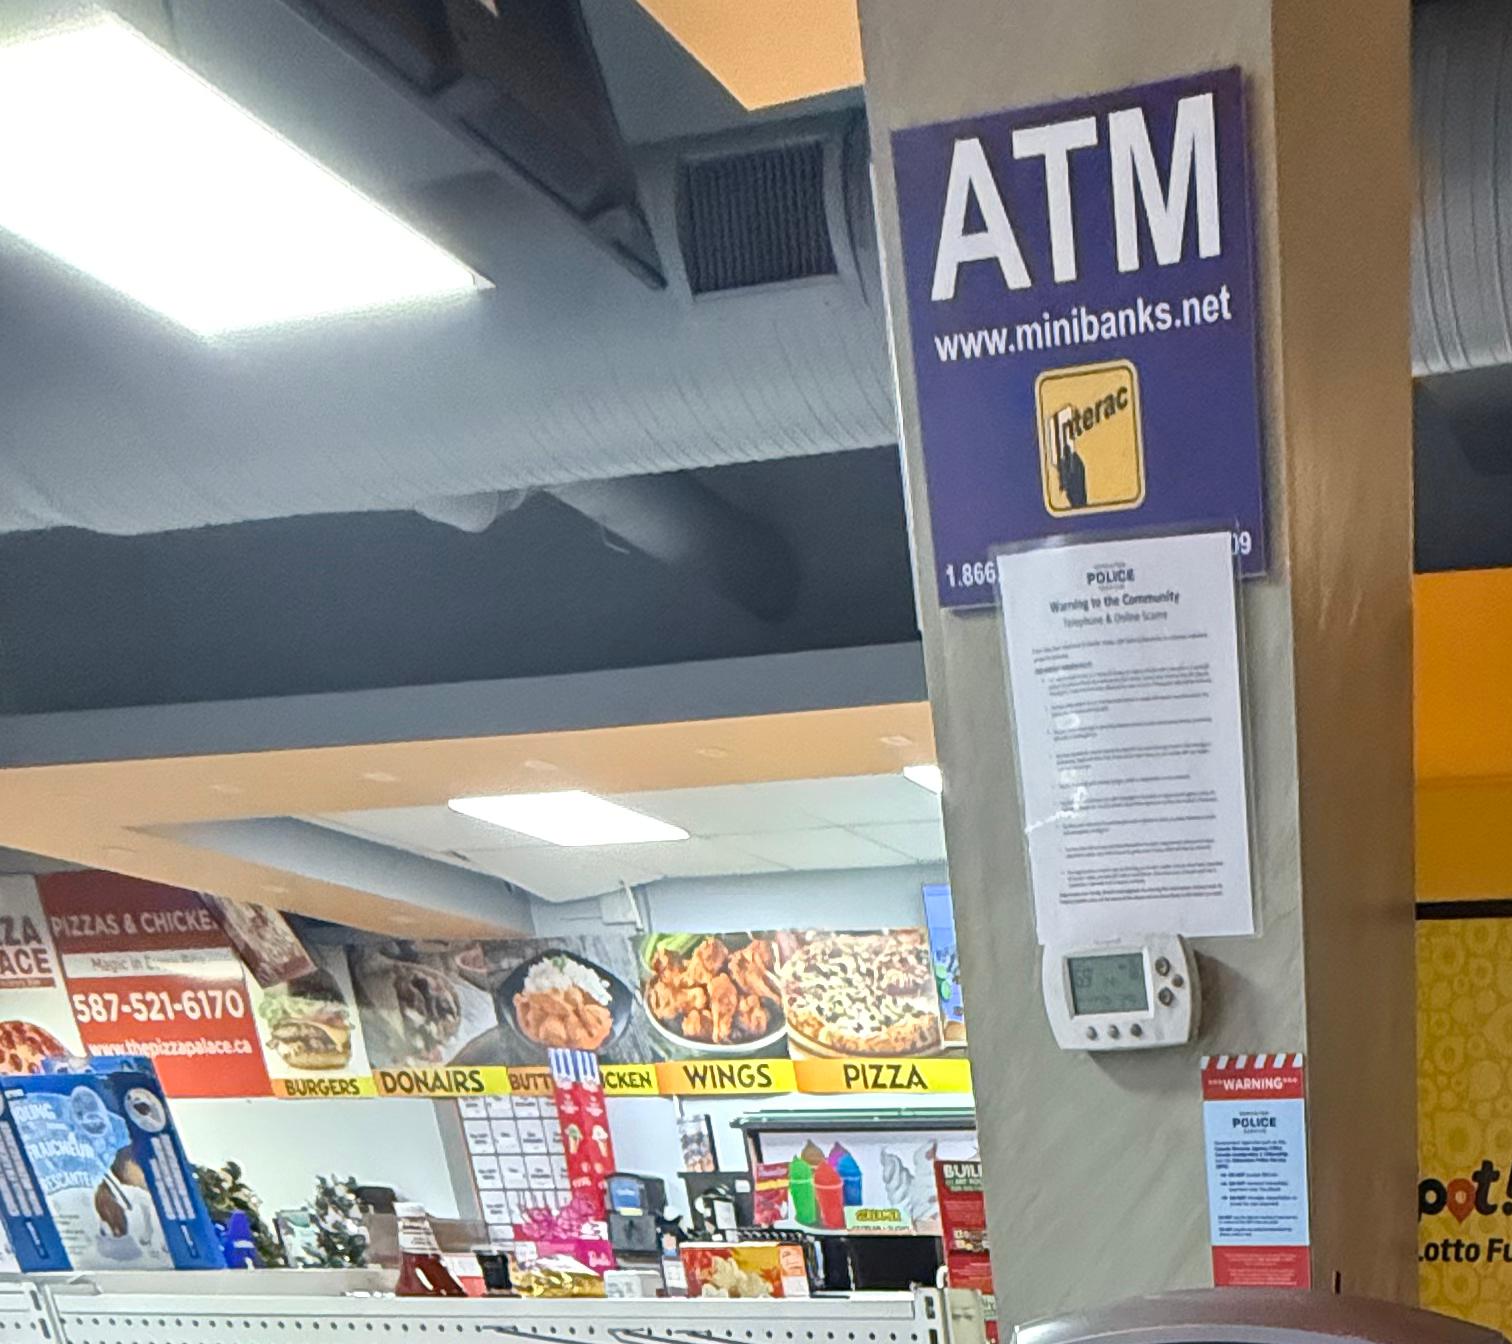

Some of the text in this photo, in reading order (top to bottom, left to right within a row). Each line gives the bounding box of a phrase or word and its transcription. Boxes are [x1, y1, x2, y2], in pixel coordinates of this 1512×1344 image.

[931, 92, 1221, 301] ATM
[935, 284, 1232, 362] www.minibanks.net
[1053, 384, 1129, 446] Interac
[1086, 568, 1135, 585] POLICE
[1050, 590, 1180, 613] Warning to the Community
[51, 909, 218, 938] PIZZAS & CHICKE
[72, 988, 246, 1024] 587-521-6170
[285, 1079, 360, 1097] BURGERS
[380, 1070, 485, 1094] DONAIRS
[510, 1070, 653, 1091] BUTT ICKEN
[685, 1064, 773, 1090] WINGS
[844, 1062, 929, 1090] PIZZA
[1223, 1076, 1284, 1091] WARNING
[1232, 1117, 1277, 1128] POLICE
[1418, 1239, 1481, 1263] otto
